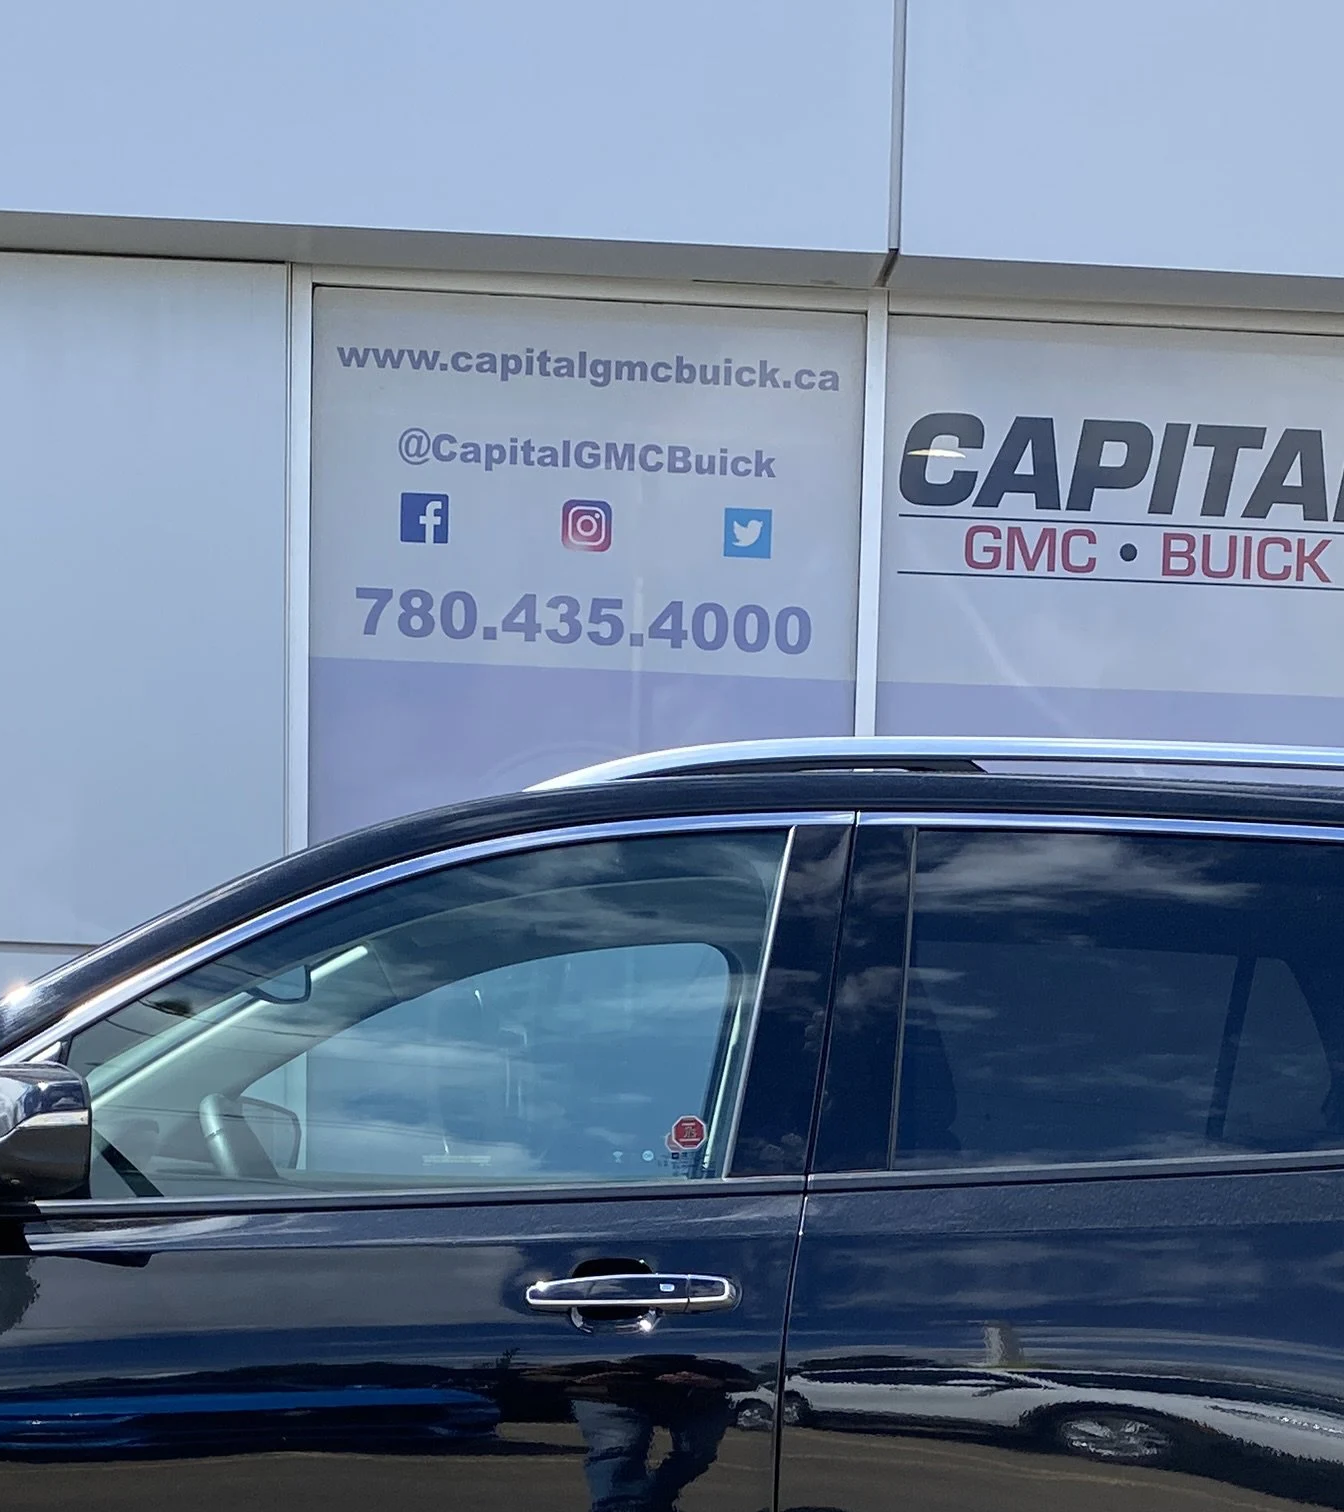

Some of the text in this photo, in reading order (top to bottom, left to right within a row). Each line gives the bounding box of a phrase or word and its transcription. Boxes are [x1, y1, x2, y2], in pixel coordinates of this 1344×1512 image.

[336, 343, 840, 392] www.capitalgmcbuick.ca
[397, 427, 777, 479] @CapitalGMCBuick
[963, 524, 1333, 583] GMC BUICK
[354, 586, 813, 656] 780.435.4000
